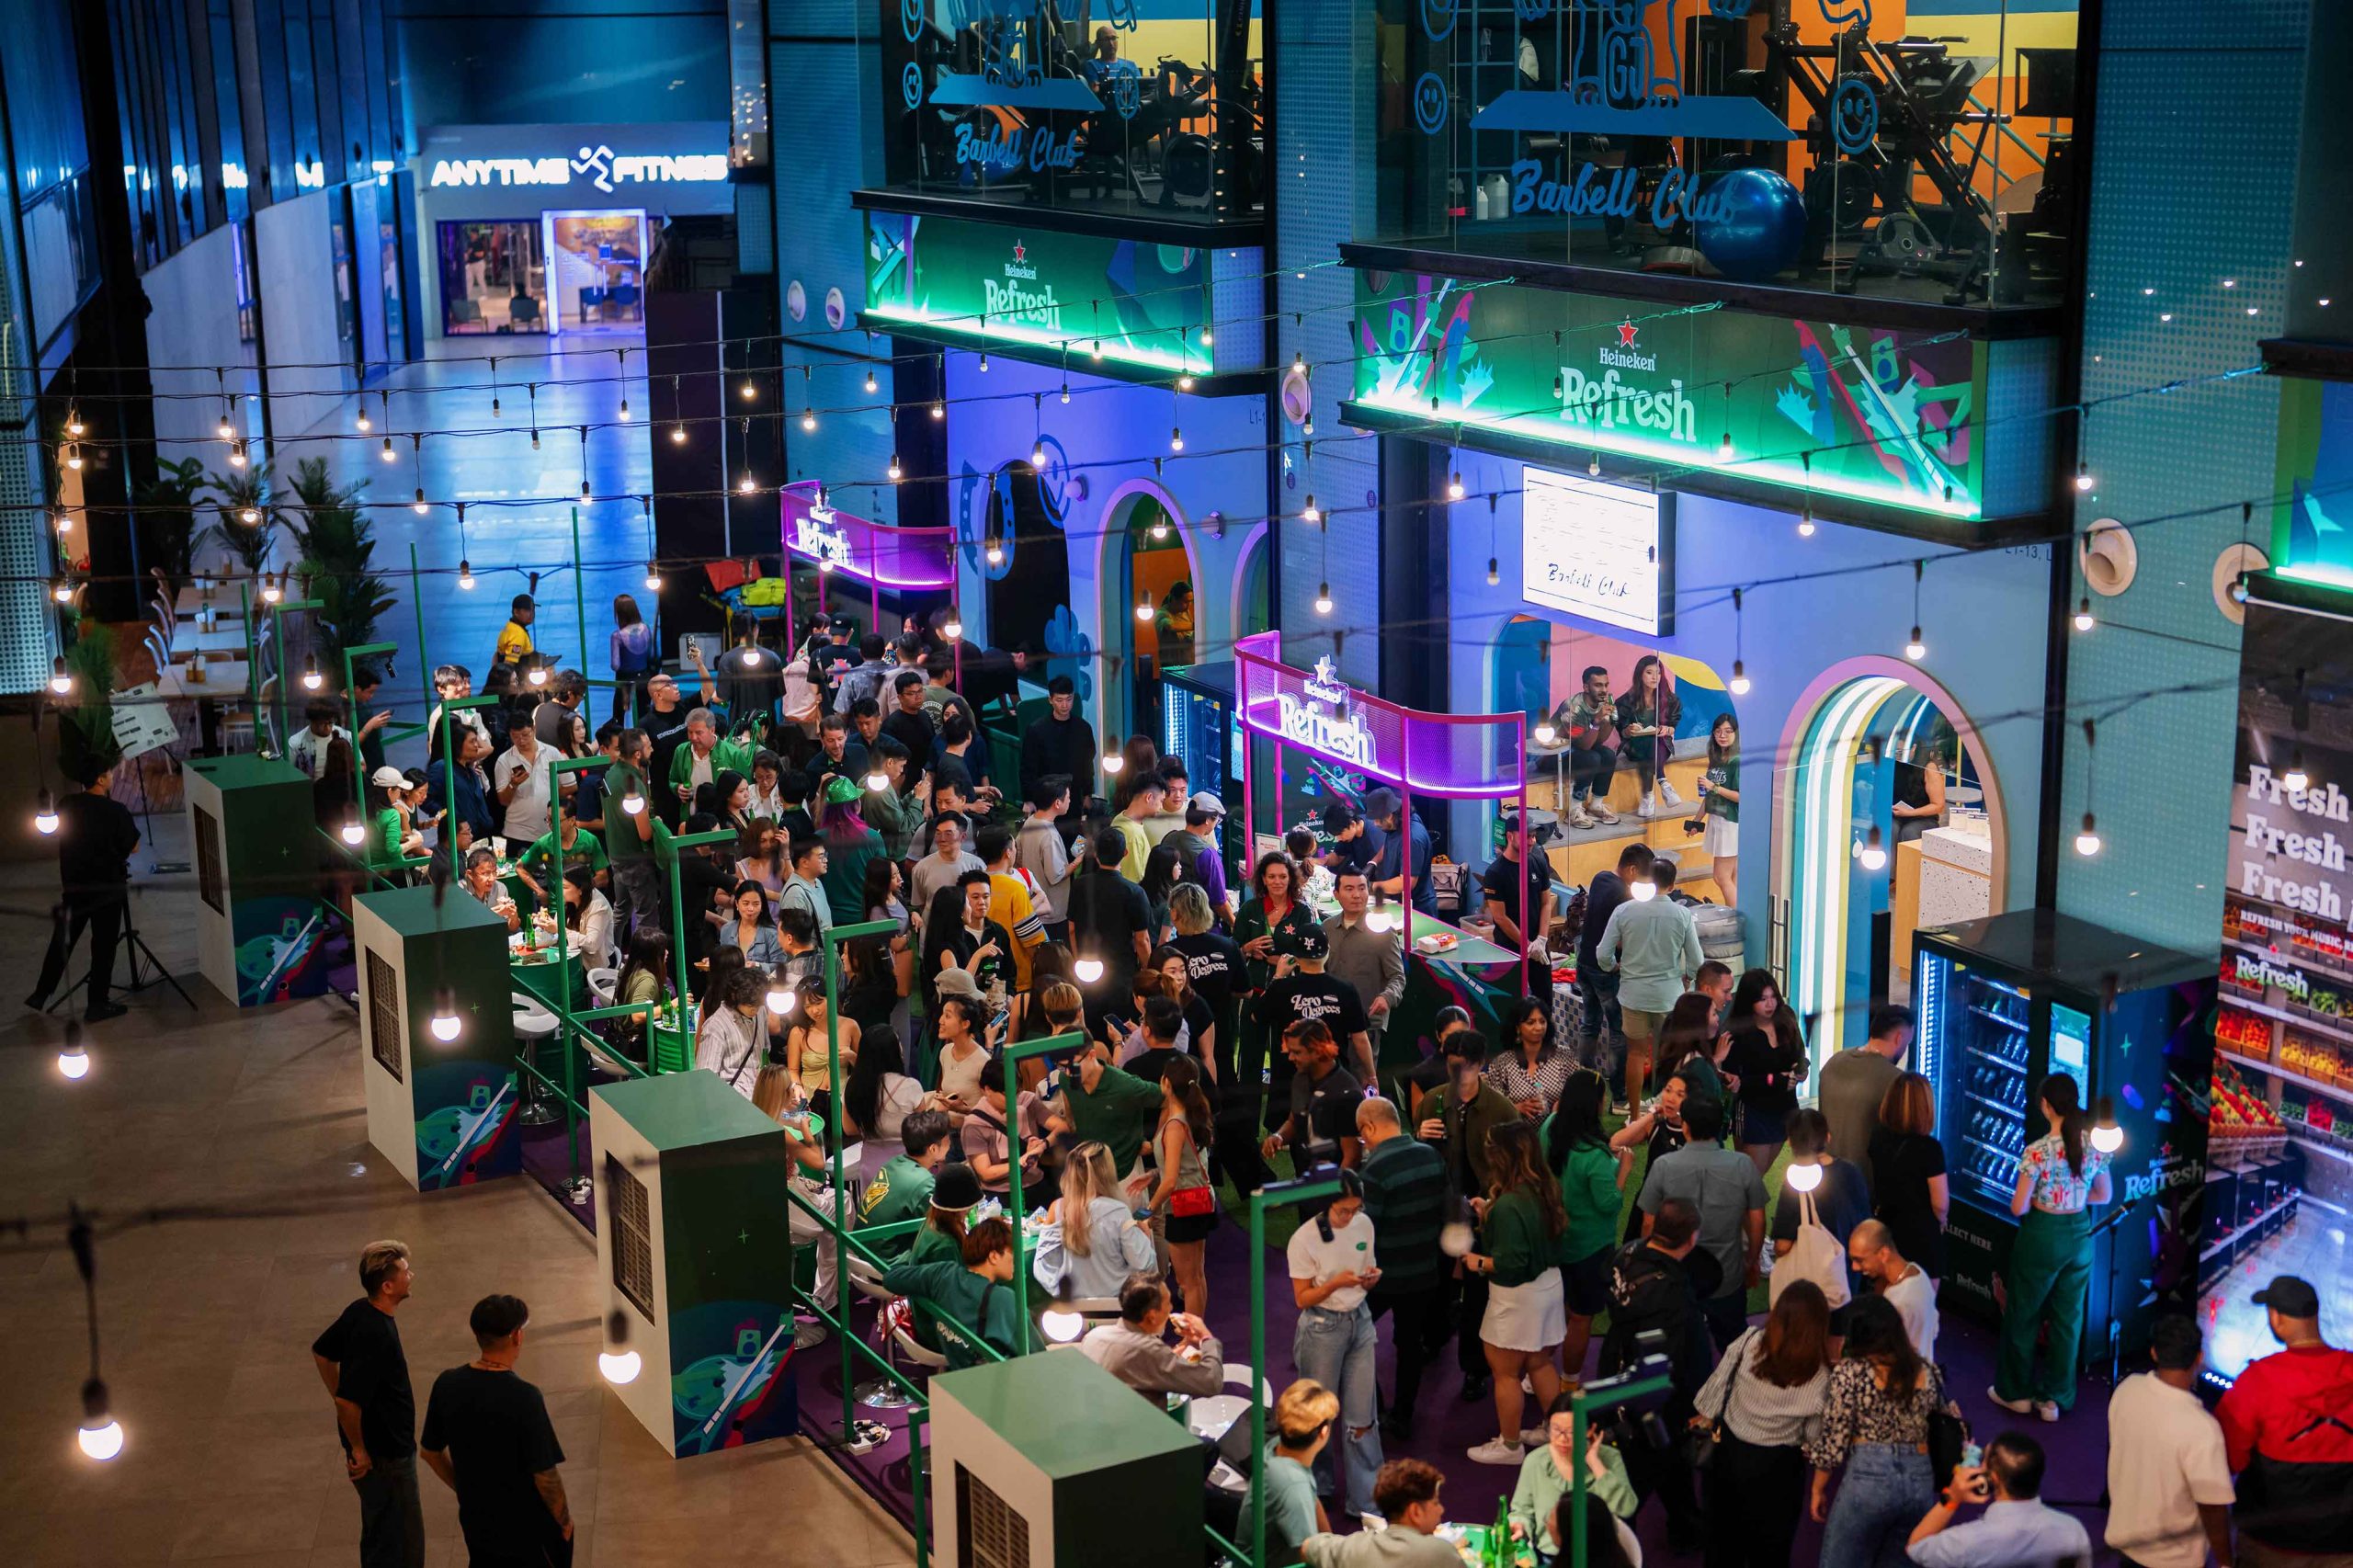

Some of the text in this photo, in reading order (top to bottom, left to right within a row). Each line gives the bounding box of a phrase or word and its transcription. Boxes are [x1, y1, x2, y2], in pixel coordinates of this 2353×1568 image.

[954, 121, 1084, 173] Barbell Club
[431, 158, 570, 187] ANYTIME
[1511, 157, 1740, 229] Barbell Club
[1005, 263, 1037, 280] Heineken
[983, 278, 1062, 331] Refresh
[1599, 347, 1655, 371] Heineken
[1560, 367, 1697, 442] Refresh
[1278, 693, 1370, 768] Refresh
[2247, 764, 2349, 823] Fresh
[2245, 812, 2346, 871] Fresh
[2241, 860, 2342, 921] Fresh
[2241, 909, 2282, 931] REFRESH
[1187, 955, 1209, 970] ero
[1190, 962, 1229, 979] Degrees
[2235, 954, 2309, 999] Refresh
[1290, 994, 1322, 1011] Zero
[1302, 1006, 1341, 1019] Degrees
[2123, 1159, 2204, 1202] Refresh
